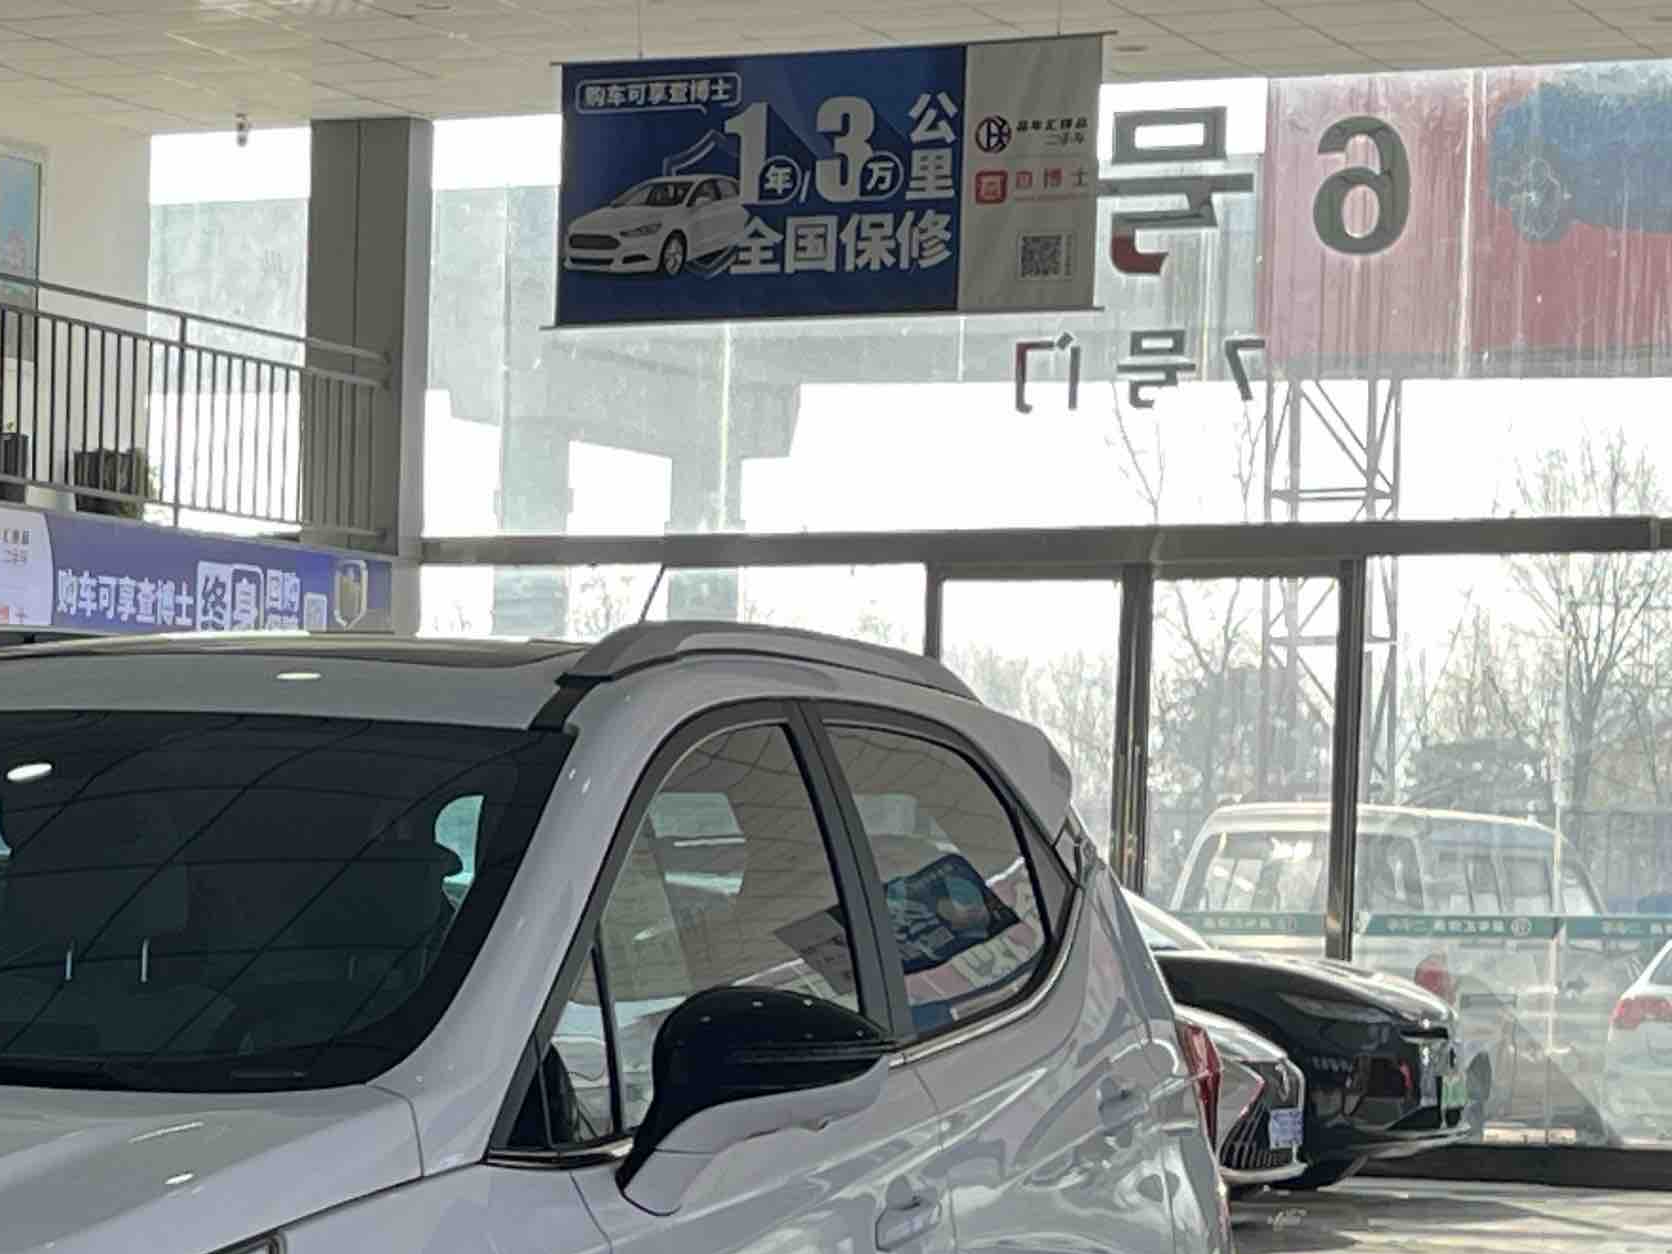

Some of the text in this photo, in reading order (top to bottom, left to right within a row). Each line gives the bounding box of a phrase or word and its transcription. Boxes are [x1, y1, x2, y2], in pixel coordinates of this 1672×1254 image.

[584, 78, 732, 107] 购车可享查博士
[729, 209, 953, 274] 全国保修
[57, 567, 195, 627] 购车可享查博士
